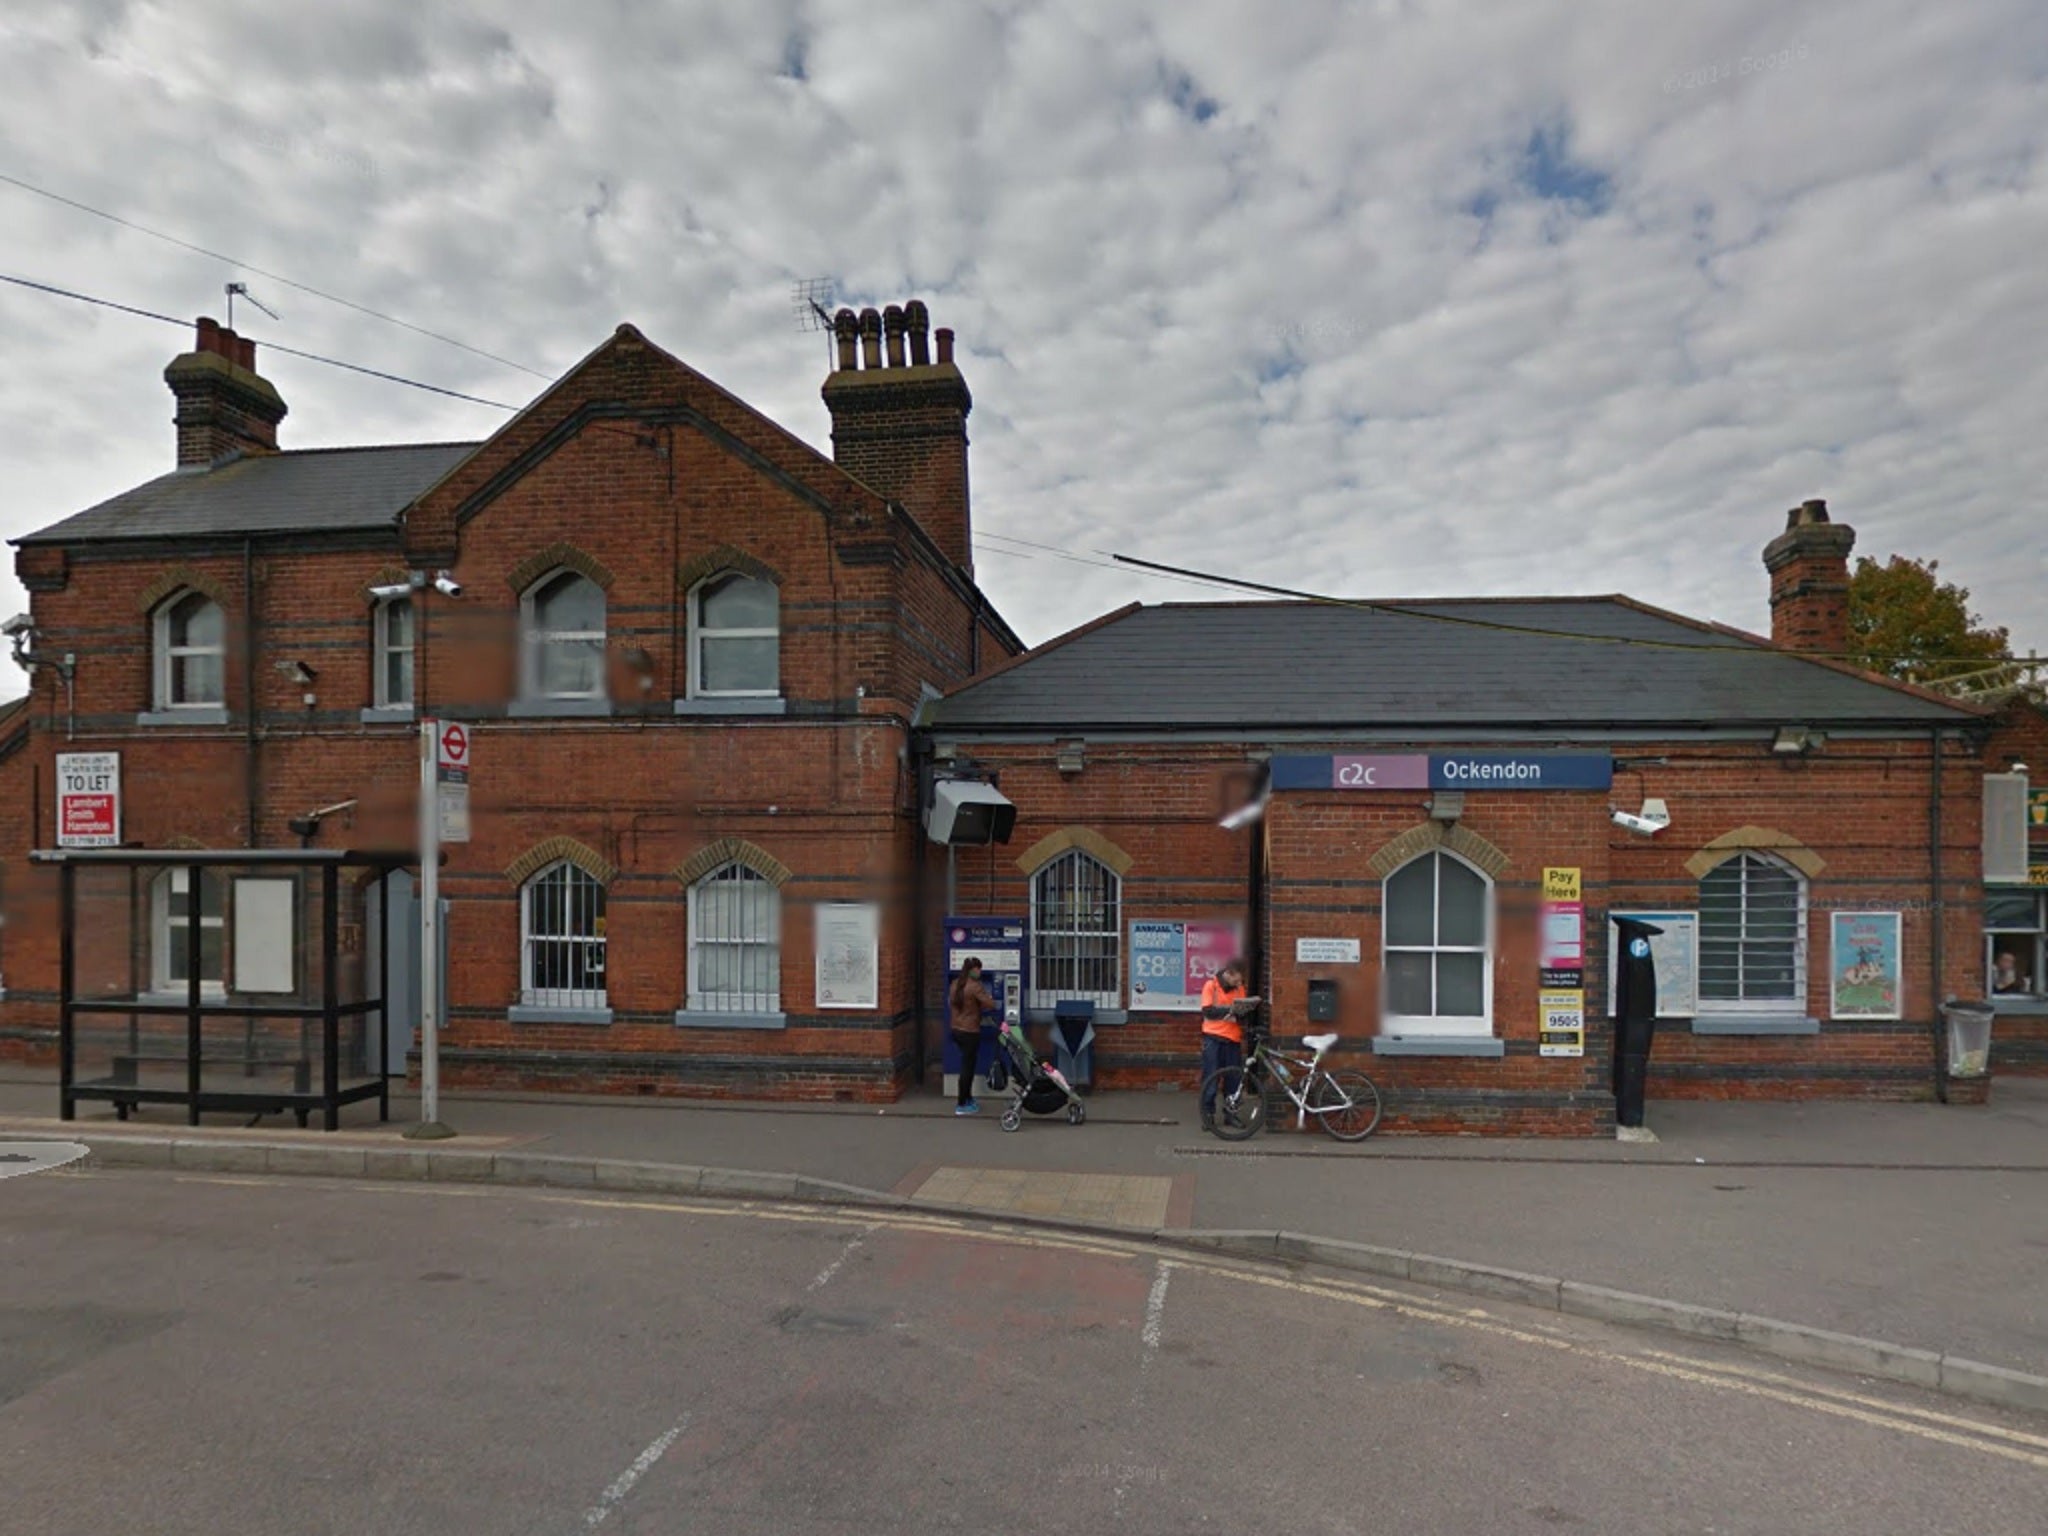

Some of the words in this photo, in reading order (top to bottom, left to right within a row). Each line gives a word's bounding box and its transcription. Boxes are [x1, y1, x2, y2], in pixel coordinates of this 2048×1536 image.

[1339, 763, 1376, 785] c2c
[1443, 760, 1541, 780] Ockendon
[65, 775, 85, 791] TO
[88, 775, 111, 791] LET
[66, 797, 108, 809] Lambert
[66, 821, 111, 833] Hampton
[1549, 870, 1574, 885] Pay
[1546, 886, 1577, 898] Here
[1134, 925, 1172, 933] ANNUAL
[1549, 1014, 1580, 1027] 9505
